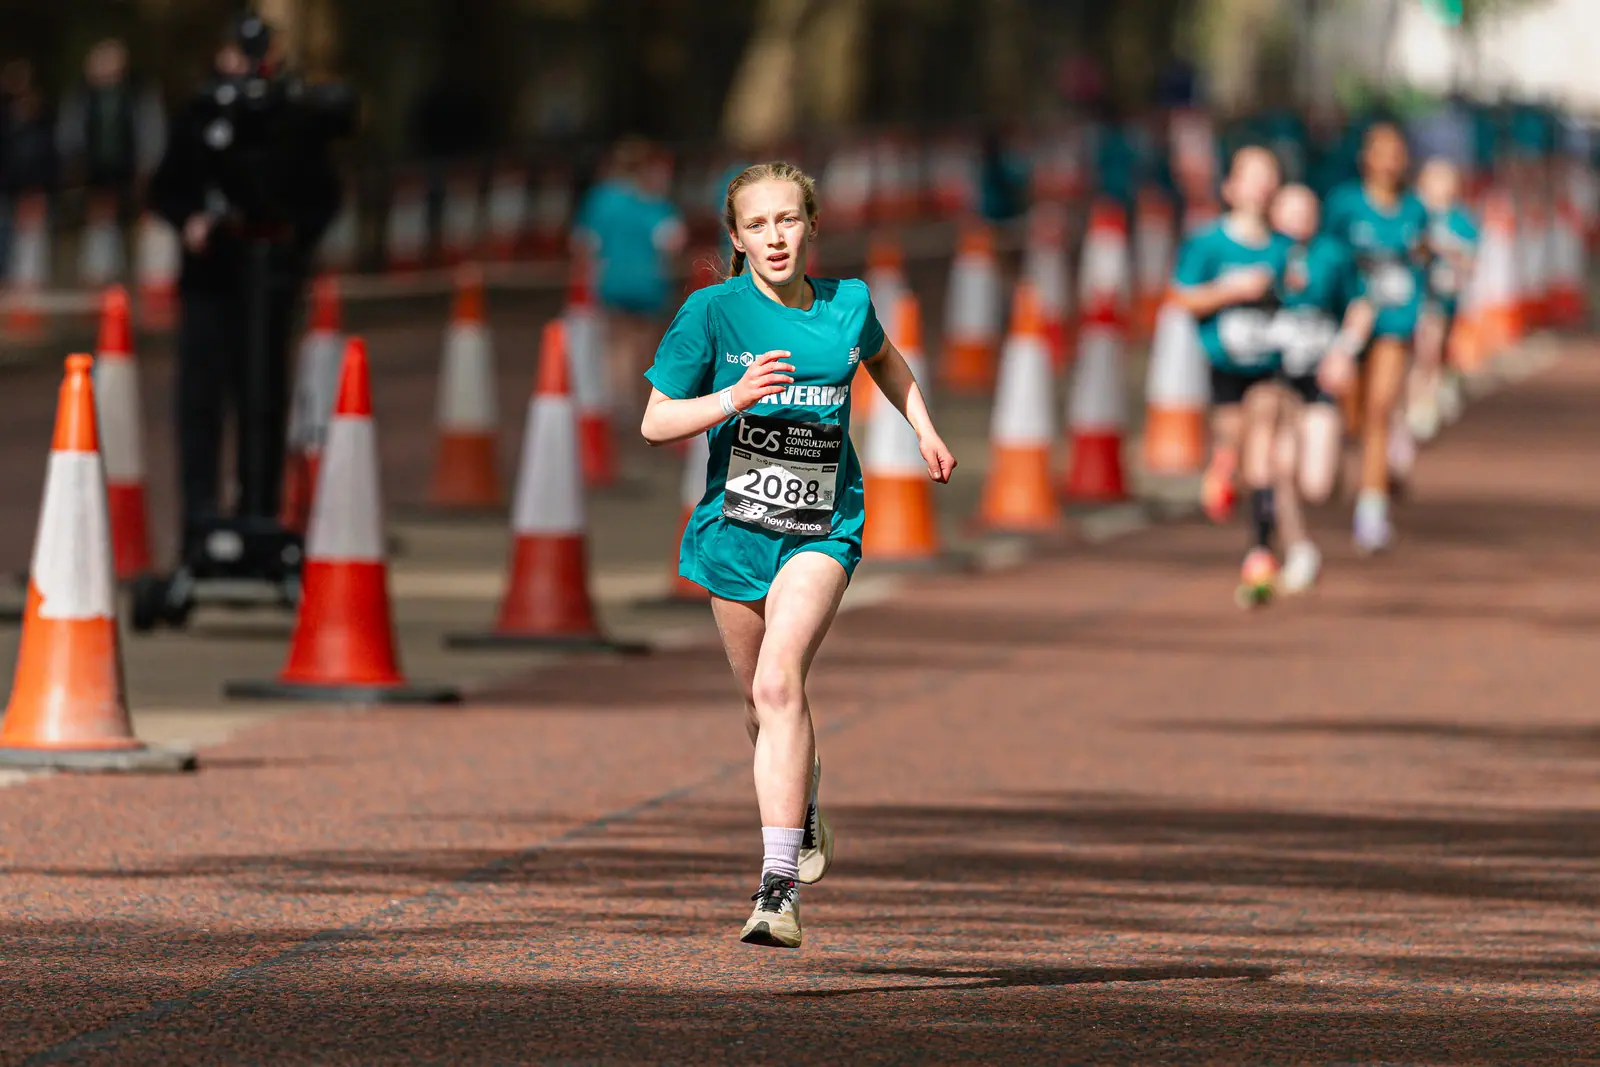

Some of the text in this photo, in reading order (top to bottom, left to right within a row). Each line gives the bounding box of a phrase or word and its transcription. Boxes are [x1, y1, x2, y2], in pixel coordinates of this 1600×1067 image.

[726, 351, 739, 364] tcs
[757, 385, 848, 406] AVERING
[738, 418, 781, 452] tcs
[787, 426, 812, 437] TATA
[785, 436, 840, 449] CONSULTANCY
[784, 446, 821, 458] SERVICES
[743, 468, 819, 505] 2088
[763, 515, 822, 531] new balance
